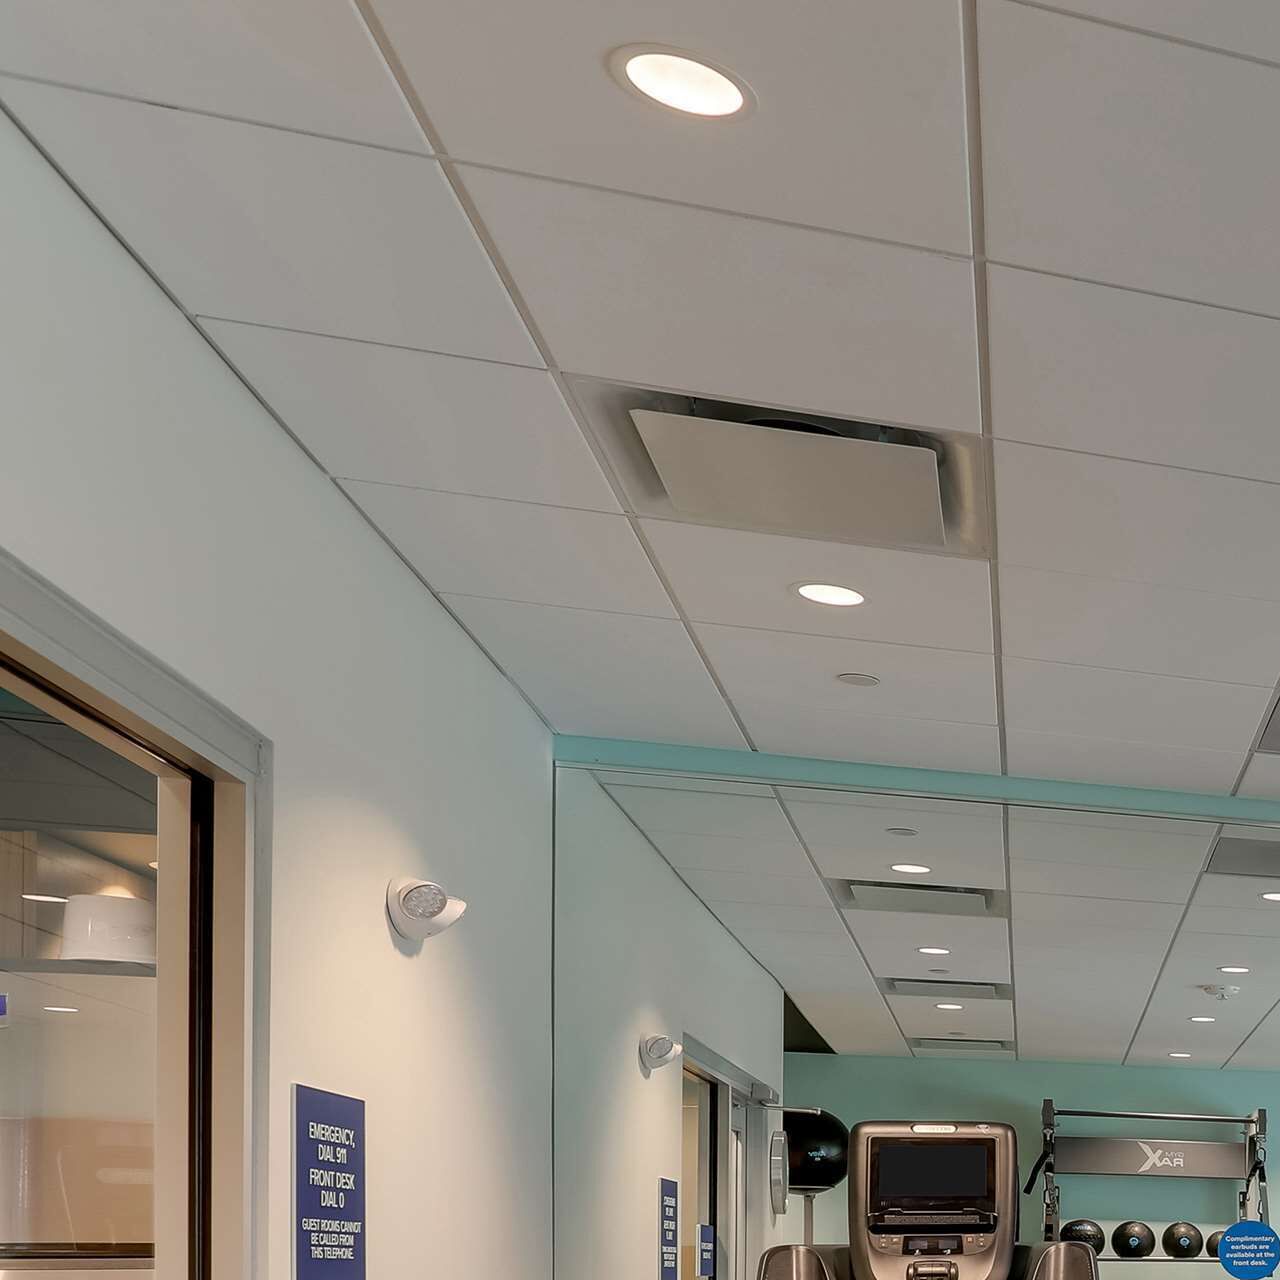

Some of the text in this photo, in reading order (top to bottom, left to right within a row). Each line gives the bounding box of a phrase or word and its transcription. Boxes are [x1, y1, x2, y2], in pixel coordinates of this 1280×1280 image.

[308, 1122, 355, 1148] EMERGENCY,
[318, 1144, 347, 1164] DIAL 911
[309, 1168, 355, 1190] FRONT DESK
[321, 1190, 345, 1208] DIAL 0
[302, 1218, 362, 1233] GUEST ROOMS CANNOT
[311, 1232, 354, 1246] BE CALLED FROM
[1225, 1235, 1275, 1243] Complimentary
[311, 1246, 323, 1258] THIS
